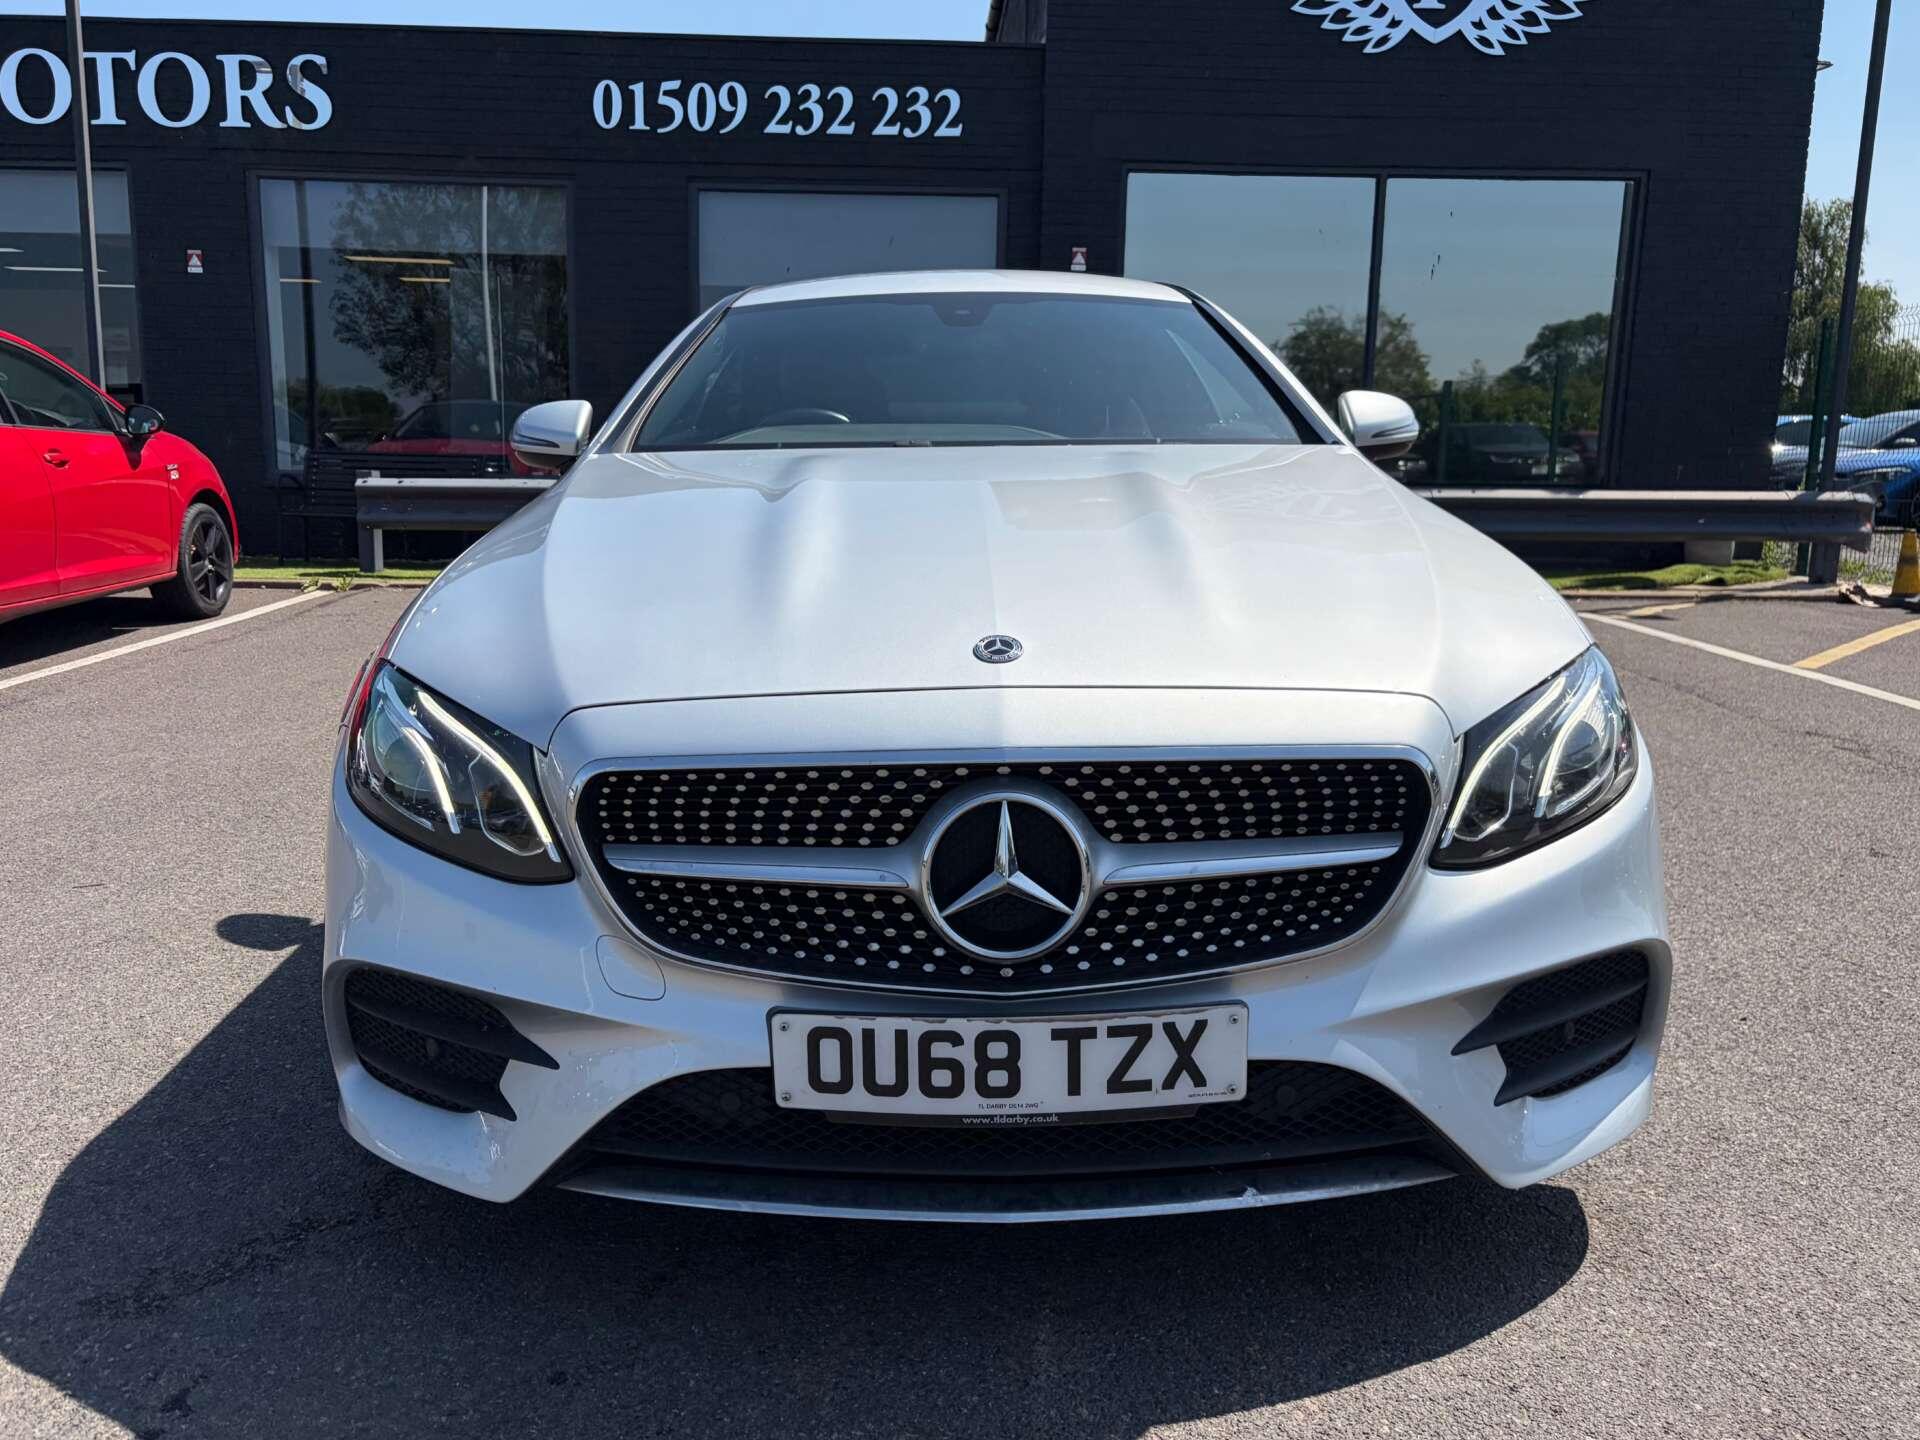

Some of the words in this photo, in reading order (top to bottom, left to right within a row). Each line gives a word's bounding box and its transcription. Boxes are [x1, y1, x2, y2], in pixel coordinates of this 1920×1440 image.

[0, 48, 333, 130] OTORS
[593, 79, 748, 134] 01509
[763, 83, 856, 136] 232
[871, 86, 963, 138] 232
[806, 1025, 1022, 1099] OU68
[1050, 1019, 1209, 1096] TZX
[962, 1113, 1059, 1125] www.tldarby.co.uk
